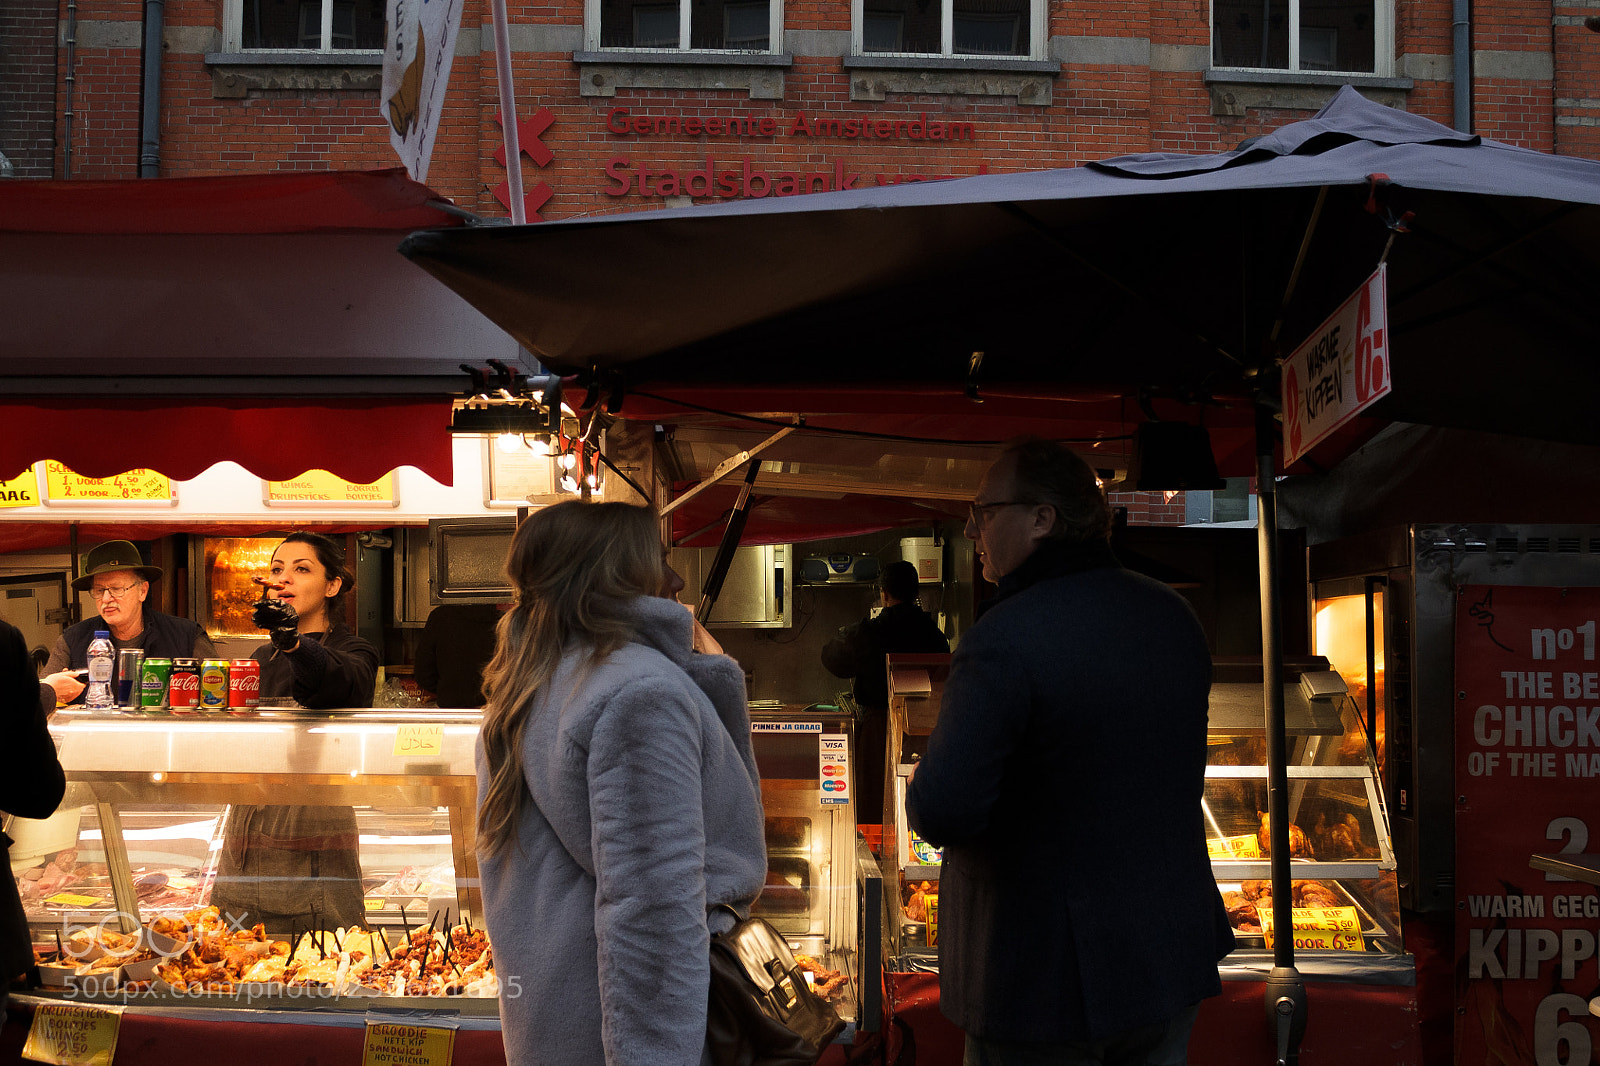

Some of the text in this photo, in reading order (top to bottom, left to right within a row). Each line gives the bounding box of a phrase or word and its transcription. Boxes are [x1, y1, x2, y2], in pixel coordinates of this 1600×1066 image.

[606, 107, 976, 141] Gemeente Amsterdam
[604, 155, 861, 199] Stadsbank
[270, 492, 331, 501] DRUMSTICKS
[1501, 671, 1554, 700] THE
[1472, 704, 1600, 748] CHICK
[1467, 751, 1600, 779] OF THE MA
[1545, 816, 1589, 882] 2
[1322, 909, 1344, 919] KIP
[1467, 894, 1600, 919] WARM GEG
[1326, 920, 1354, 933] 3.50
[41, 1005, 111, 1020] DRUMSTICKS
[45, 1029, 88, 1042] WINGS
[384, 1036, 425, 1047] HETE KIP
[369, 1044, 423, 1056] SANDWICH
[374, 1053, 430, 1065] HOT CHICKEN
